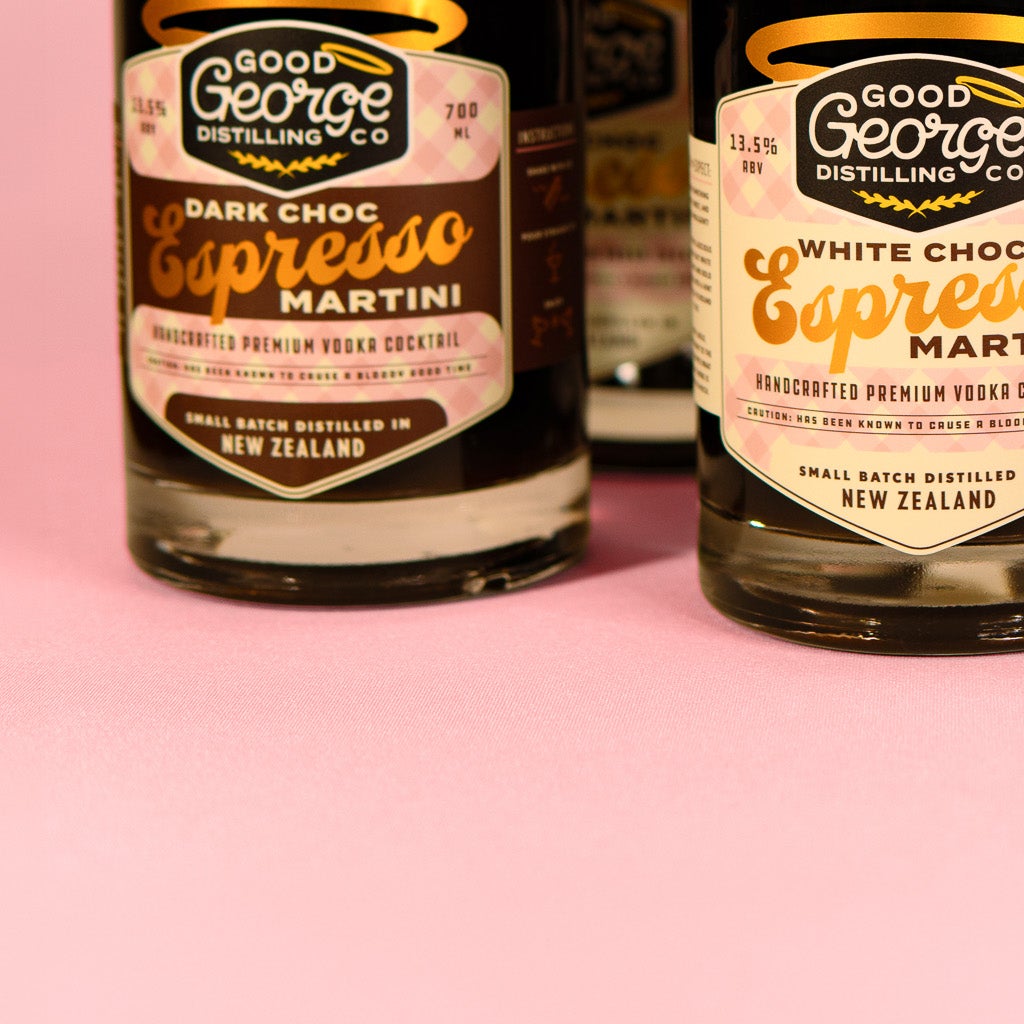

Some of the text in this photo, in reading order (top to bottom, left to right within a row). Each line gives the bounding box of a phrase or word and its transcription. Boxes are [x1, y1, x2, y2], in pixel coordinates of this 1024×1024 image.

[235, 49, 337, 74] GOOD
[190, 57, 394, 138] George
[861, 84, 971, 109] GOOD
[445, 101, 479, 121] 700
[197, 125, 390, 146] DISTILLING CO
[454, 127, 471, 141] ML
[729, 133, 779, 157] 13.5%
[742, 159, 764, 176] ABV
[816, 164, 1024, 184] DISTILLING CO
[185, 197, 380, 224] DARK CHOC
[799, 239, 912, 263] WHITE
[143, 202, 474, 326] Espresso
[279, 283, 463, 315] MARTINI
[243, 335, 315, 355] PREMIUM
[322, 336, 377, 355] VODKA
[385, 331, 461, 353] COCKTAIL
[755, 373, 858, 401] HANDCRAFTED
[866, 381, 946, 403] PREMIUM
[954, 380, 1011, 402] VODKA
[185, 411, 412, 433] SMALL BATCH DISTILLED IN
[747, 406, 792, 423] CAUTION:
[796, 413, 819, 426] HAS
[823, 416, 854, 430] BEEN
[858, 419, 903, 431] KNOWN
[907, 419, 925, 431] TO
[929, 419, 971, 431] CAUSE
[976, 418, 985, 430] A
[221, 433, 366, 459] NEW ZEALAND
[798, 465, 856, 483] SMALL
[859, 468, 918, 485] BATCH
[924, 469, 1017, 485] DISTILLED
[841, 488, 997, 511] NEW ZEALAND
